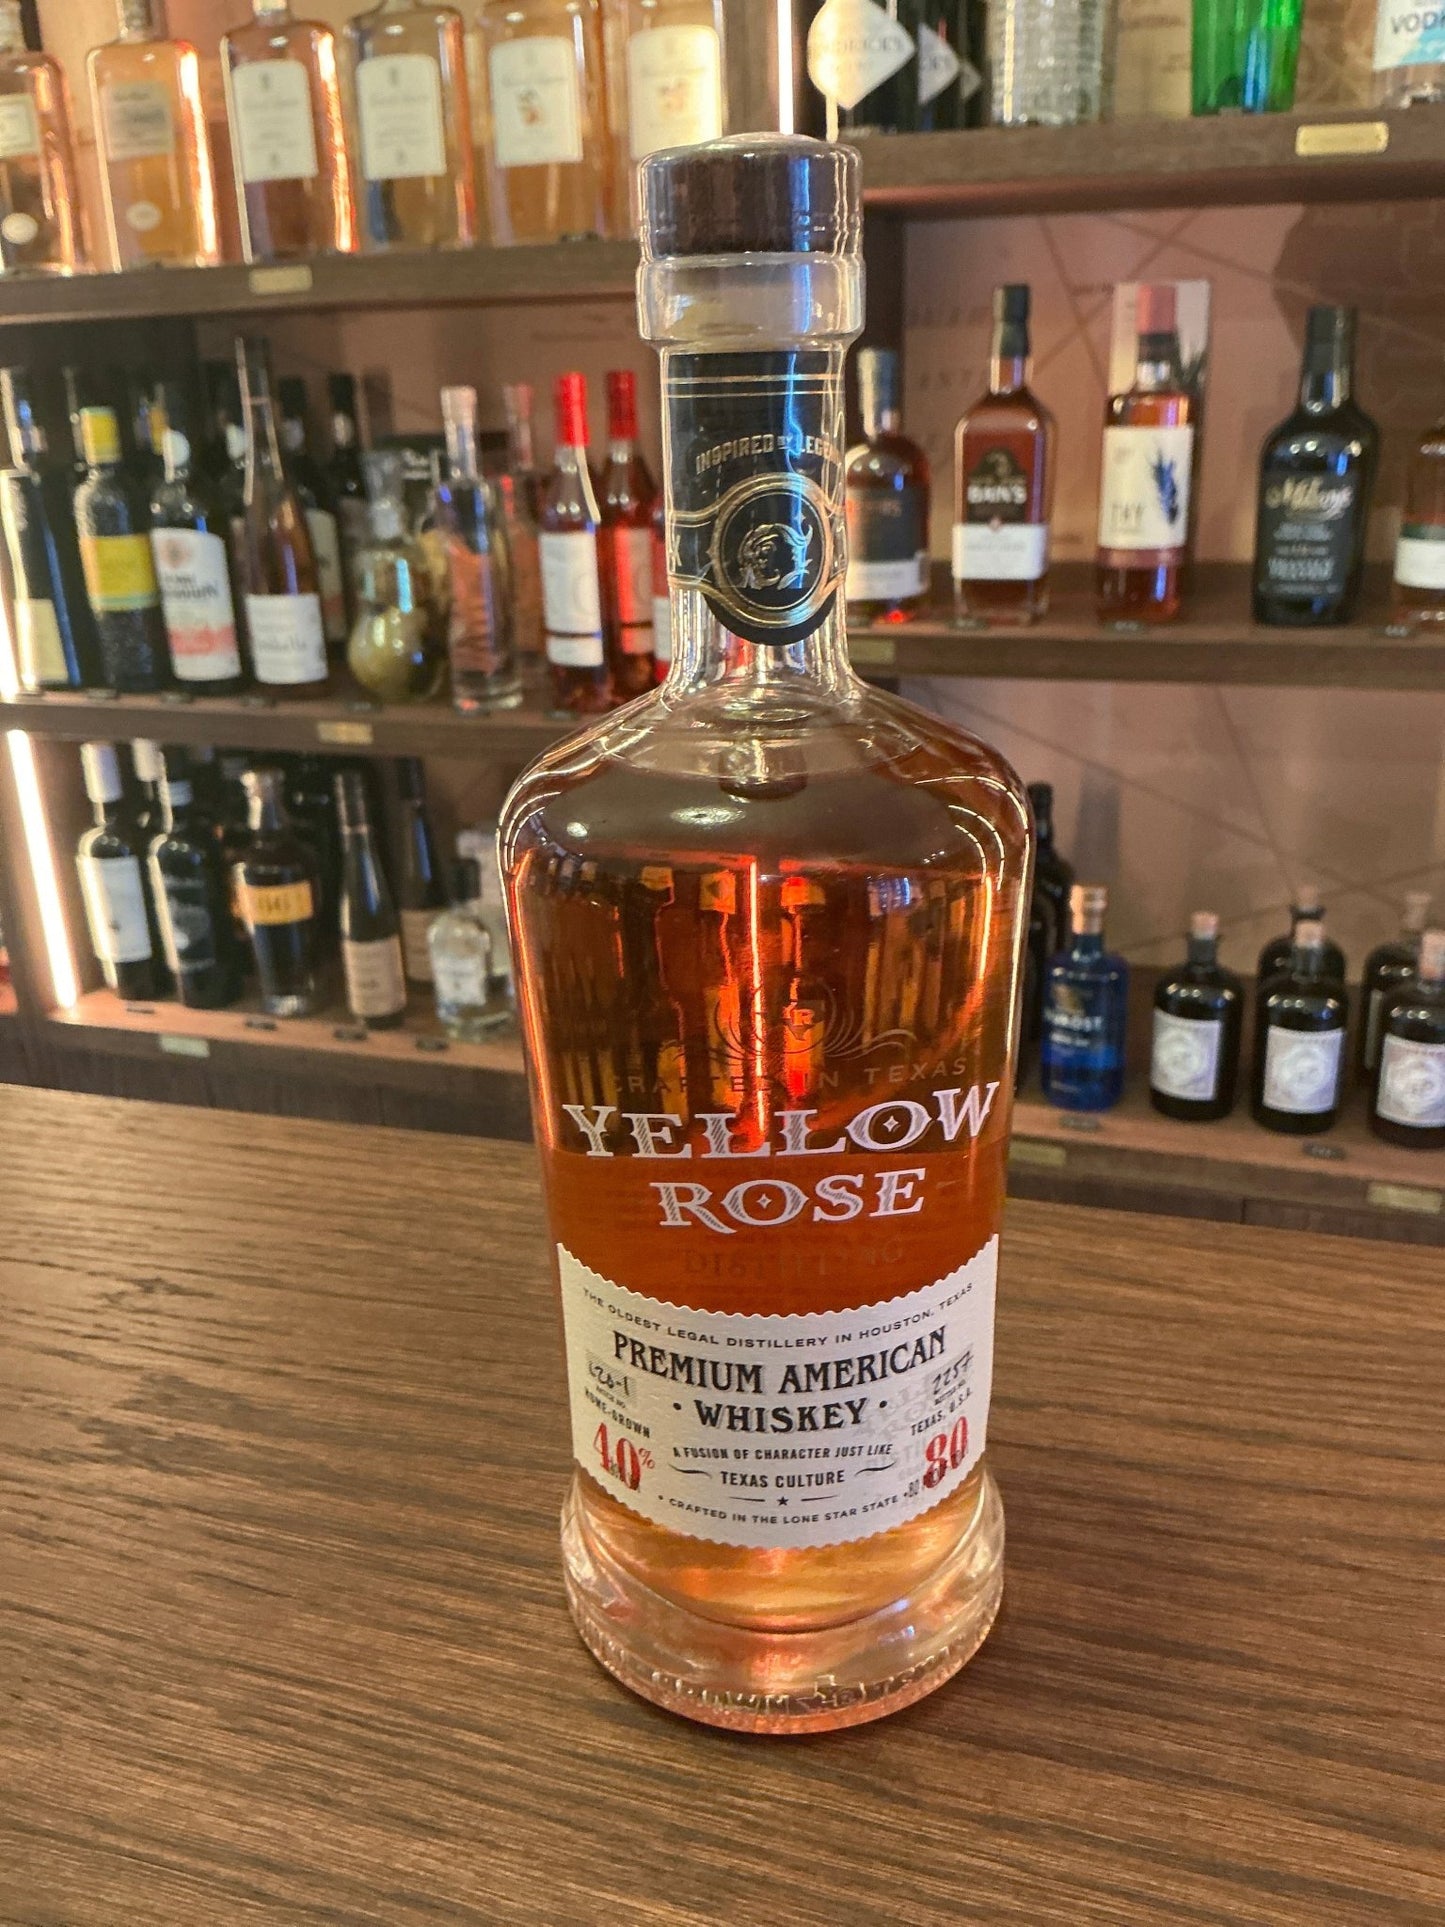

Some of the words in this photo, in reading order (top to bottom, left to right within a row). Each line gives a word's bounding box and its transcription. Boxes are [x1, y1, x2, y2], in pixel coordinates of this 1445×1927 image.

[695, 433, 775, 475] INSPIRED
[612, 1071, 774, 1095] CRAFED
[863, 1056, 967, 1085] TEXAS
[561, 1080, 1000, 1159] YELLOW
[649, 1167, 927, 1234] ROSE
[583, 1287, 604, 1308] THE
[608, 1304, 662, 1332] OLDEST
[667, 1326, 720, 1345] LEGAL
[726, 1336, 829, 1349] DISTILLERY
[836, 1333, 852, 1345] IN
[939, 1282, 974, 1311] TEXAS
[612, 1329, 764, 1395] PREMIUM
[777, 1324, 948, 1395] AMERICAN
[584, 1385, 651, 1440] HOME-GROWN
[693, 1397, 869, 1435] WHISKEY
[593, 1421, 656, 1491] 40%
[672, 1446, 681, 1458] A
[683, 1446, 729, 1460] FUSION
[733, 1448, 749, 1460] OF
[755, 1447, 831, 1460] CHARACTER
[834, 1445, 864, 1458] JUST
[867, 1443, 894, 1456] LIKE
[720, 1470, 769, 1489] TEXAS
[775, 1469, 846, 1489] CULTURE
[922, 1415, 969, 1489] 80
[668, 1497, 728, 1520] CRAFTED
[732, 1513, 747, 1523] IN
[752, 1514, 778, 1525] THE
[783, 1513, 820, 1525] LONE
[824, 1507, 858, 1521] STAR
[861, 1494, 898, 1513] STATE
